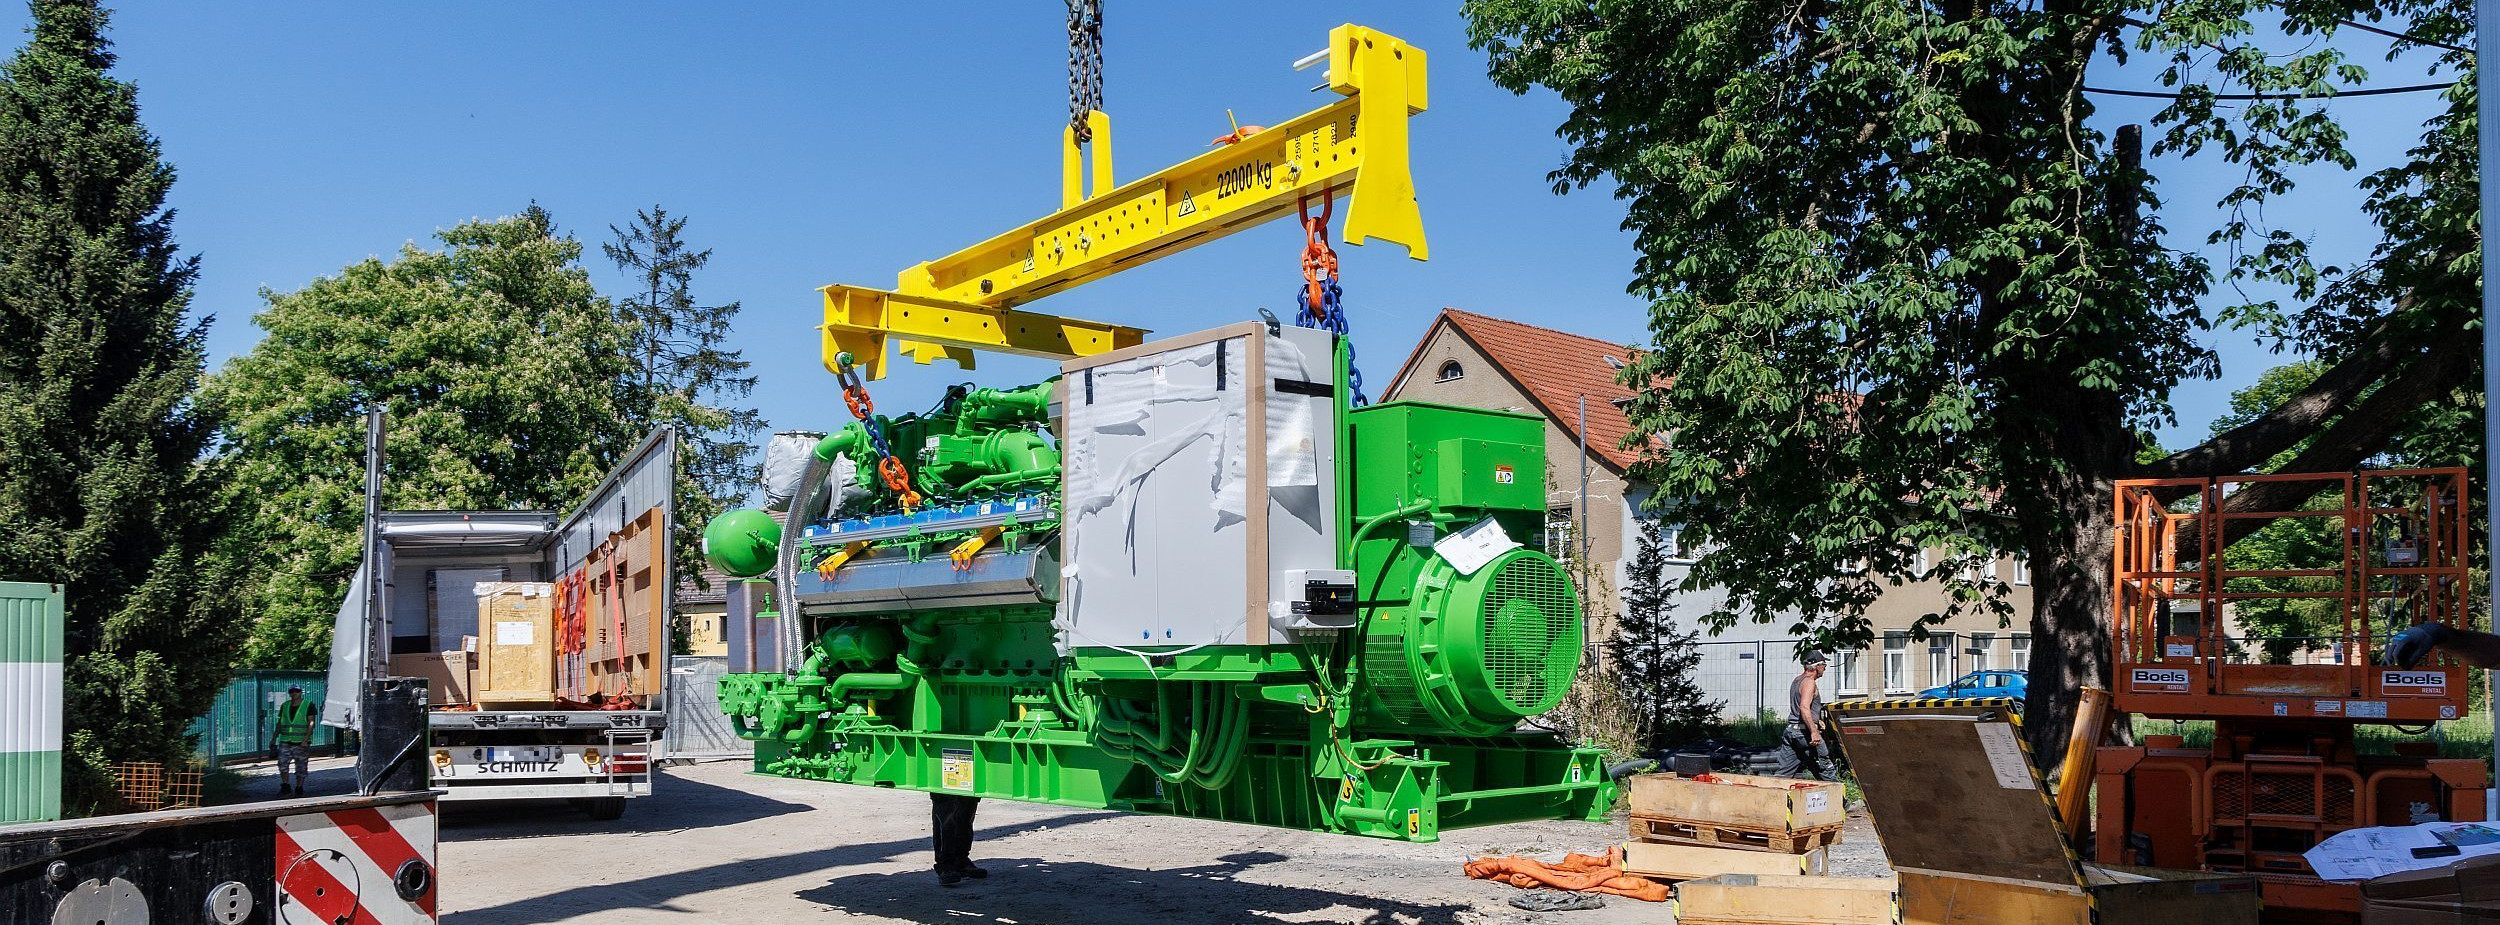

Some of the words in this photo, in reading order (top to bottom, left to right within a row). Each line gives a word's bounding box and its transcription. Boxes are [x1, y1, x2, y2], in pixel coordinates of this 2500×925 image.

[1217, 162, 1253, 200] 22000
[1257, 159, 1272, 189] kg
[2135, 671, 2186, 682] Boels
[2385, 673, 2443, 684] Boels
[478, 761, 558, 773] SCHMITZ
